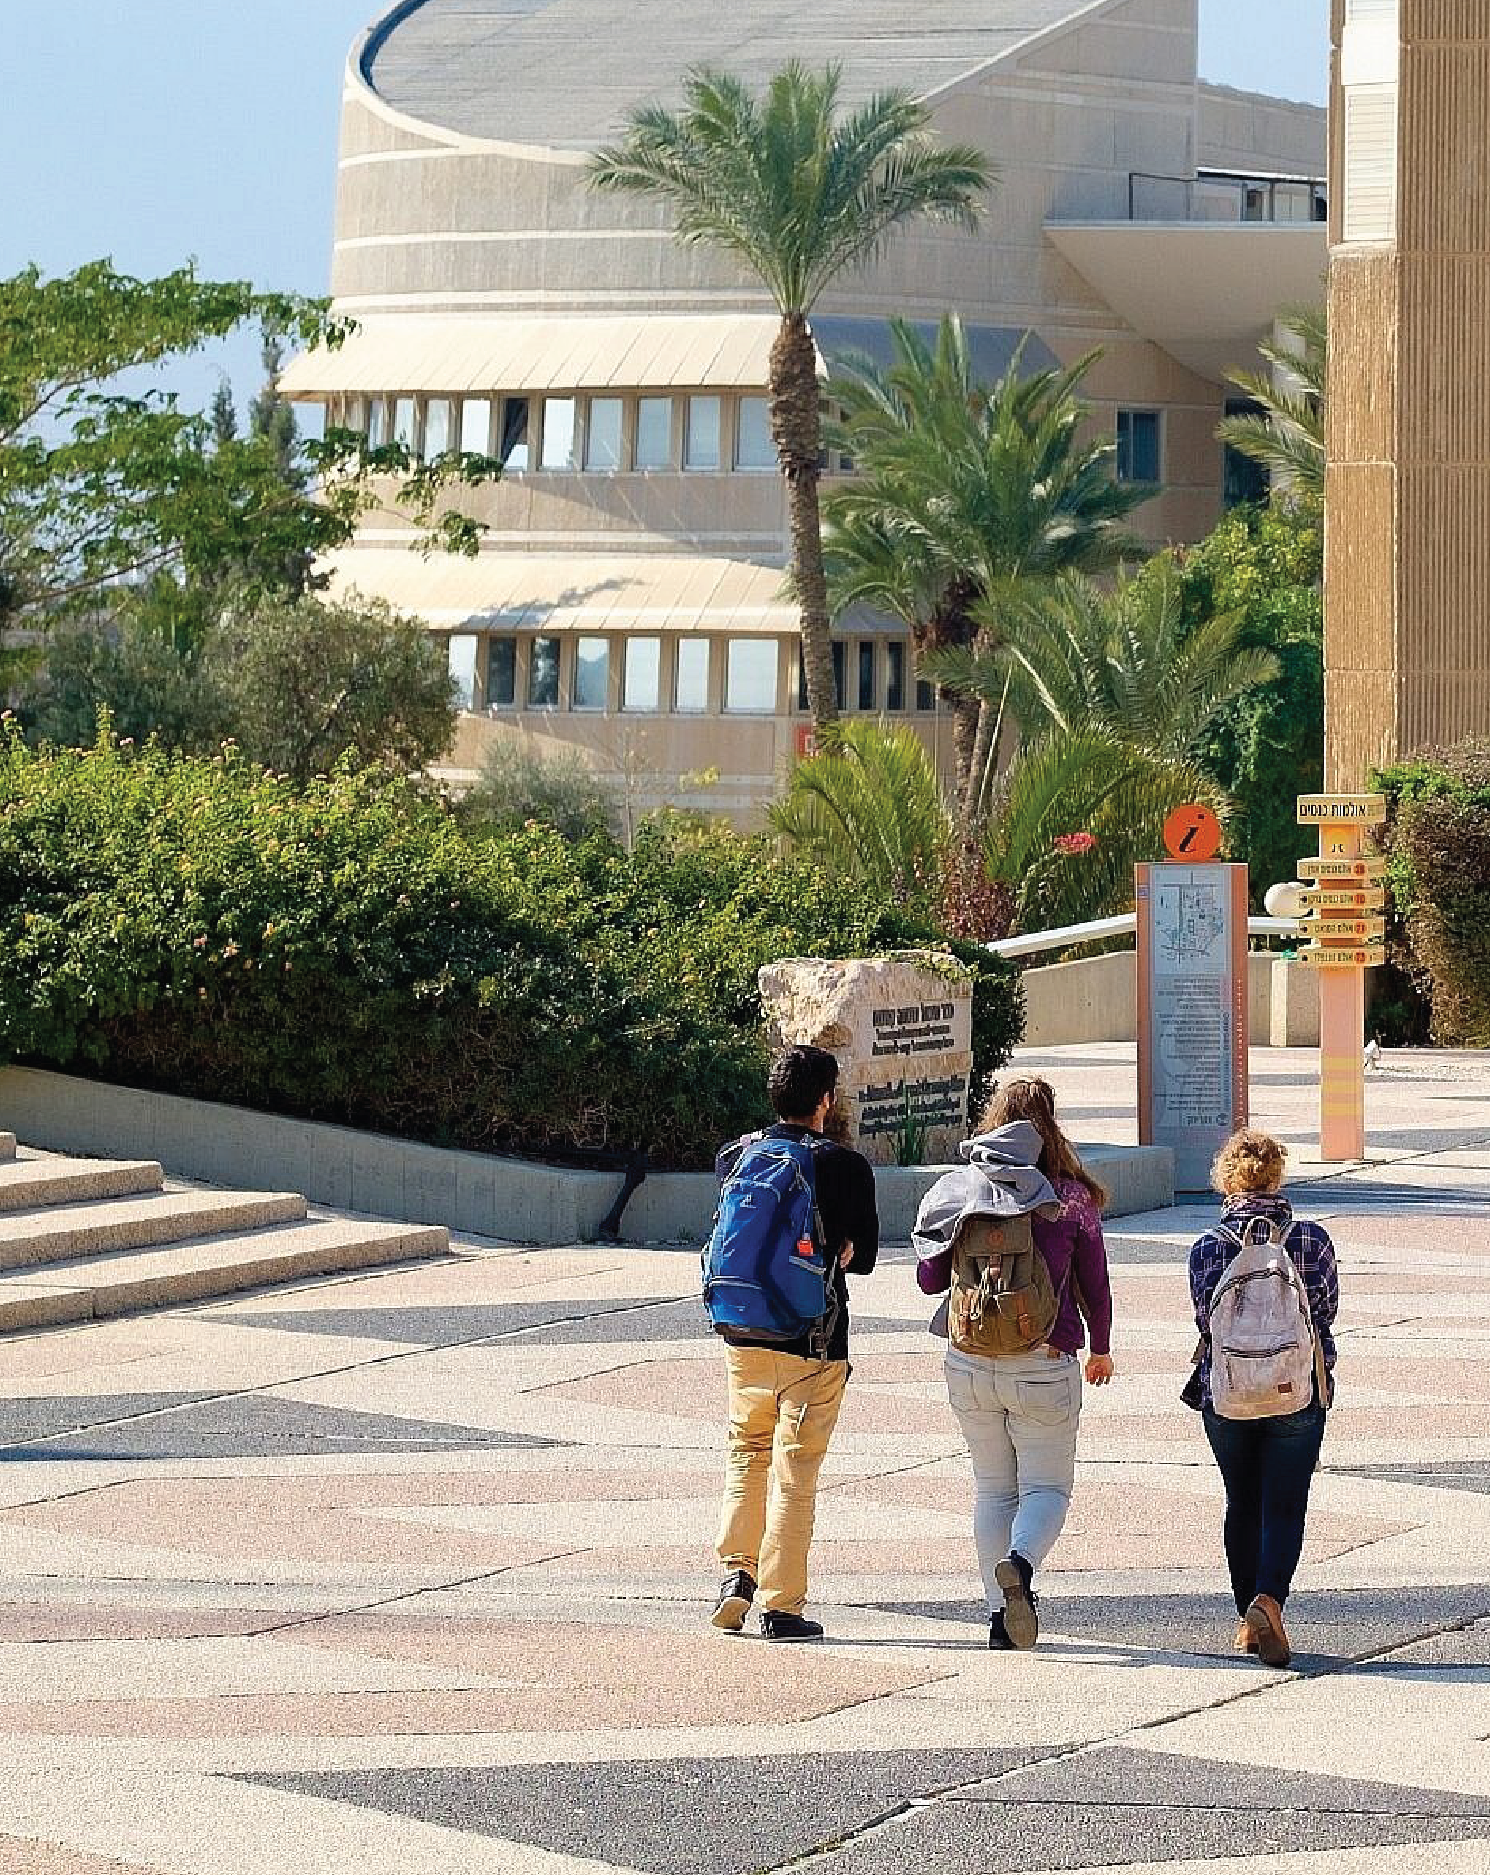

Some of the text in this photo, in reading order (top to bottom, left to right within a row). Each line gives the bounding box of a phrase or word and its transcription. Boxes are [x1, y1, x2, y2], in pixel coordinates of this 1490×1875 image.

[1299, 801, 1366, 817] אולמות כנסים
[1178, 813, 1205, 853] i
